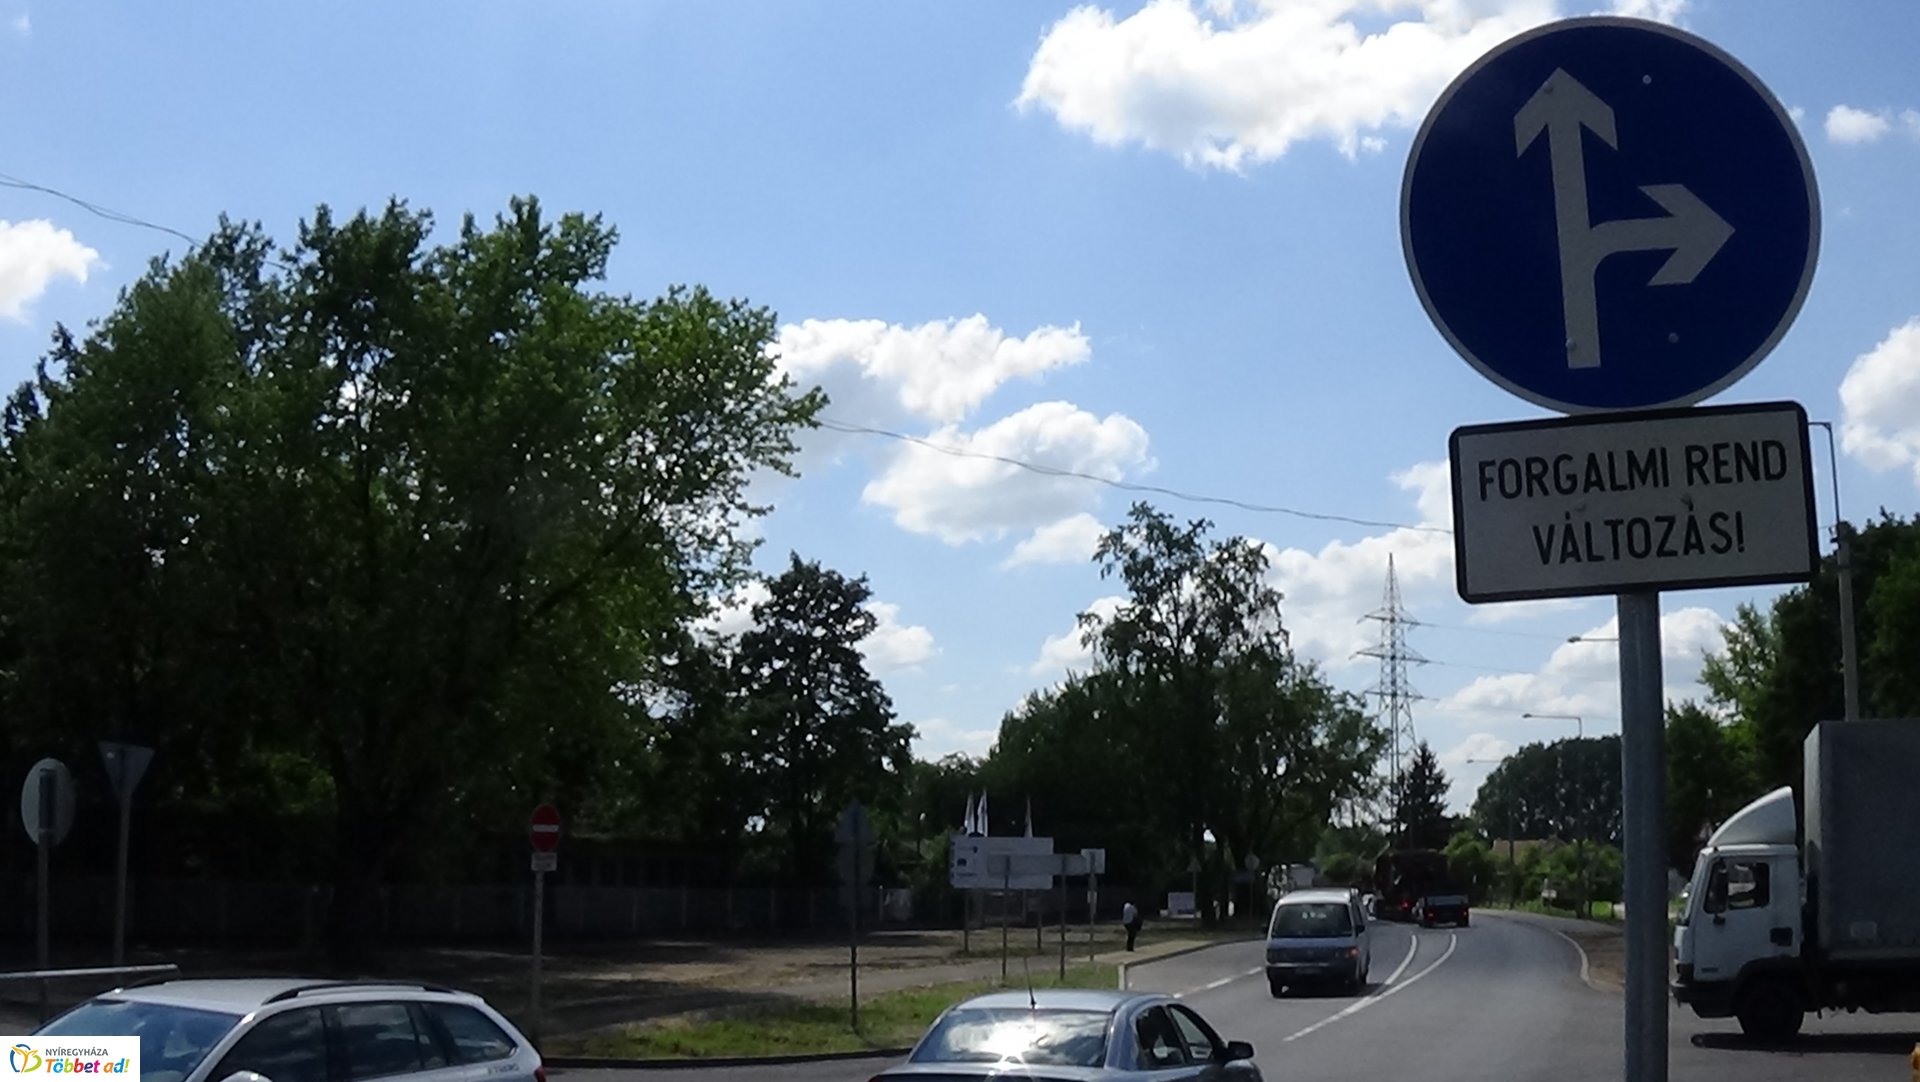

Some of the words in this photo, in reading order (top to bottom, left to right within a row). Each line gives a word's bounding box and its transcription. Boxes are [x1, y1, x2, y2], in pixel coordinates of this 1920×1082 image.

[1478, 447, 1669, 501] FORGALMI
[1684, 439, 1787, 487] REND
[1532, 504, 1746, 565] VÁLTOZÁS!
